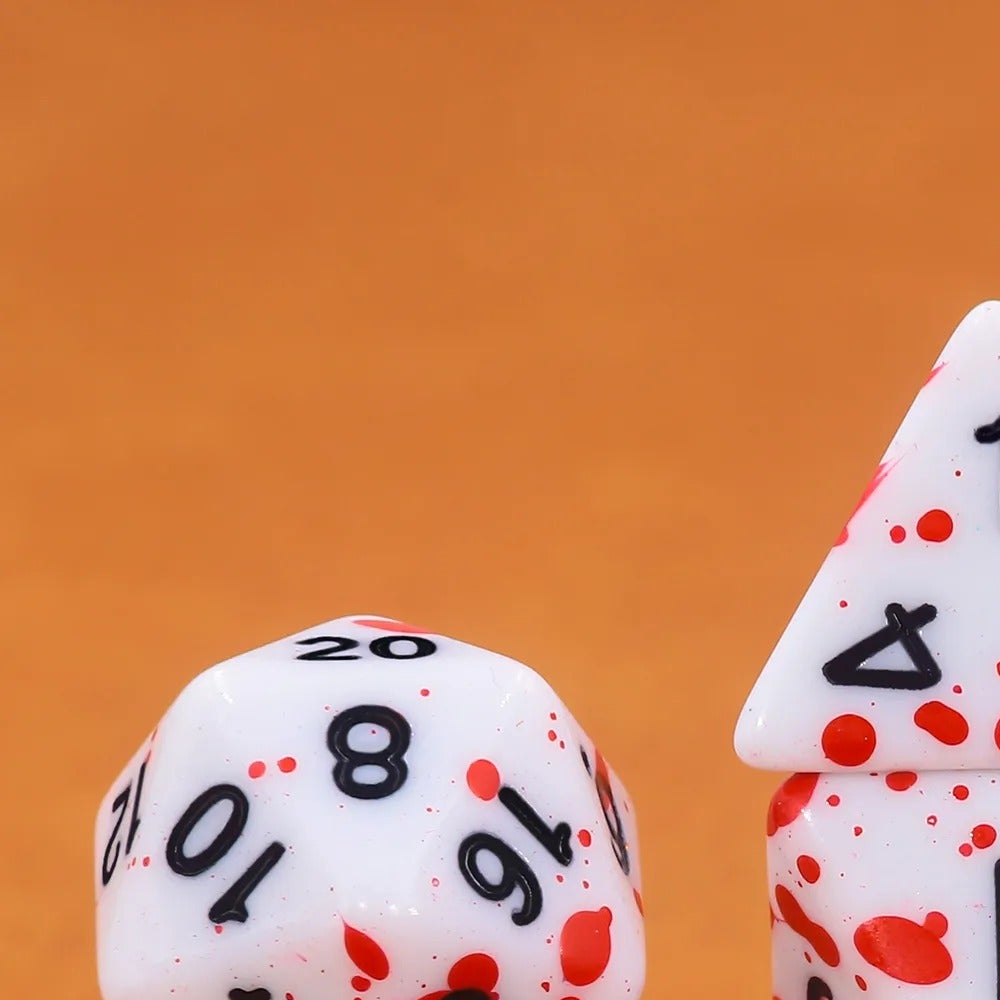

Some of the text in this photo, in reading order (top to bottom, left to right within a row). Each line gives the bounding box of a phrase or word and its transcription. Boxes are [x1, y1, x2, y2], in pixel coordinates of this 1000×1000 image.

[292, 635, 438, 661] 20
[821, 602, 942, 691] 4
[326, 704, 412, 801] 8
[165, 783, 287, 925] 10
[456, 785, 574, 928] 16
